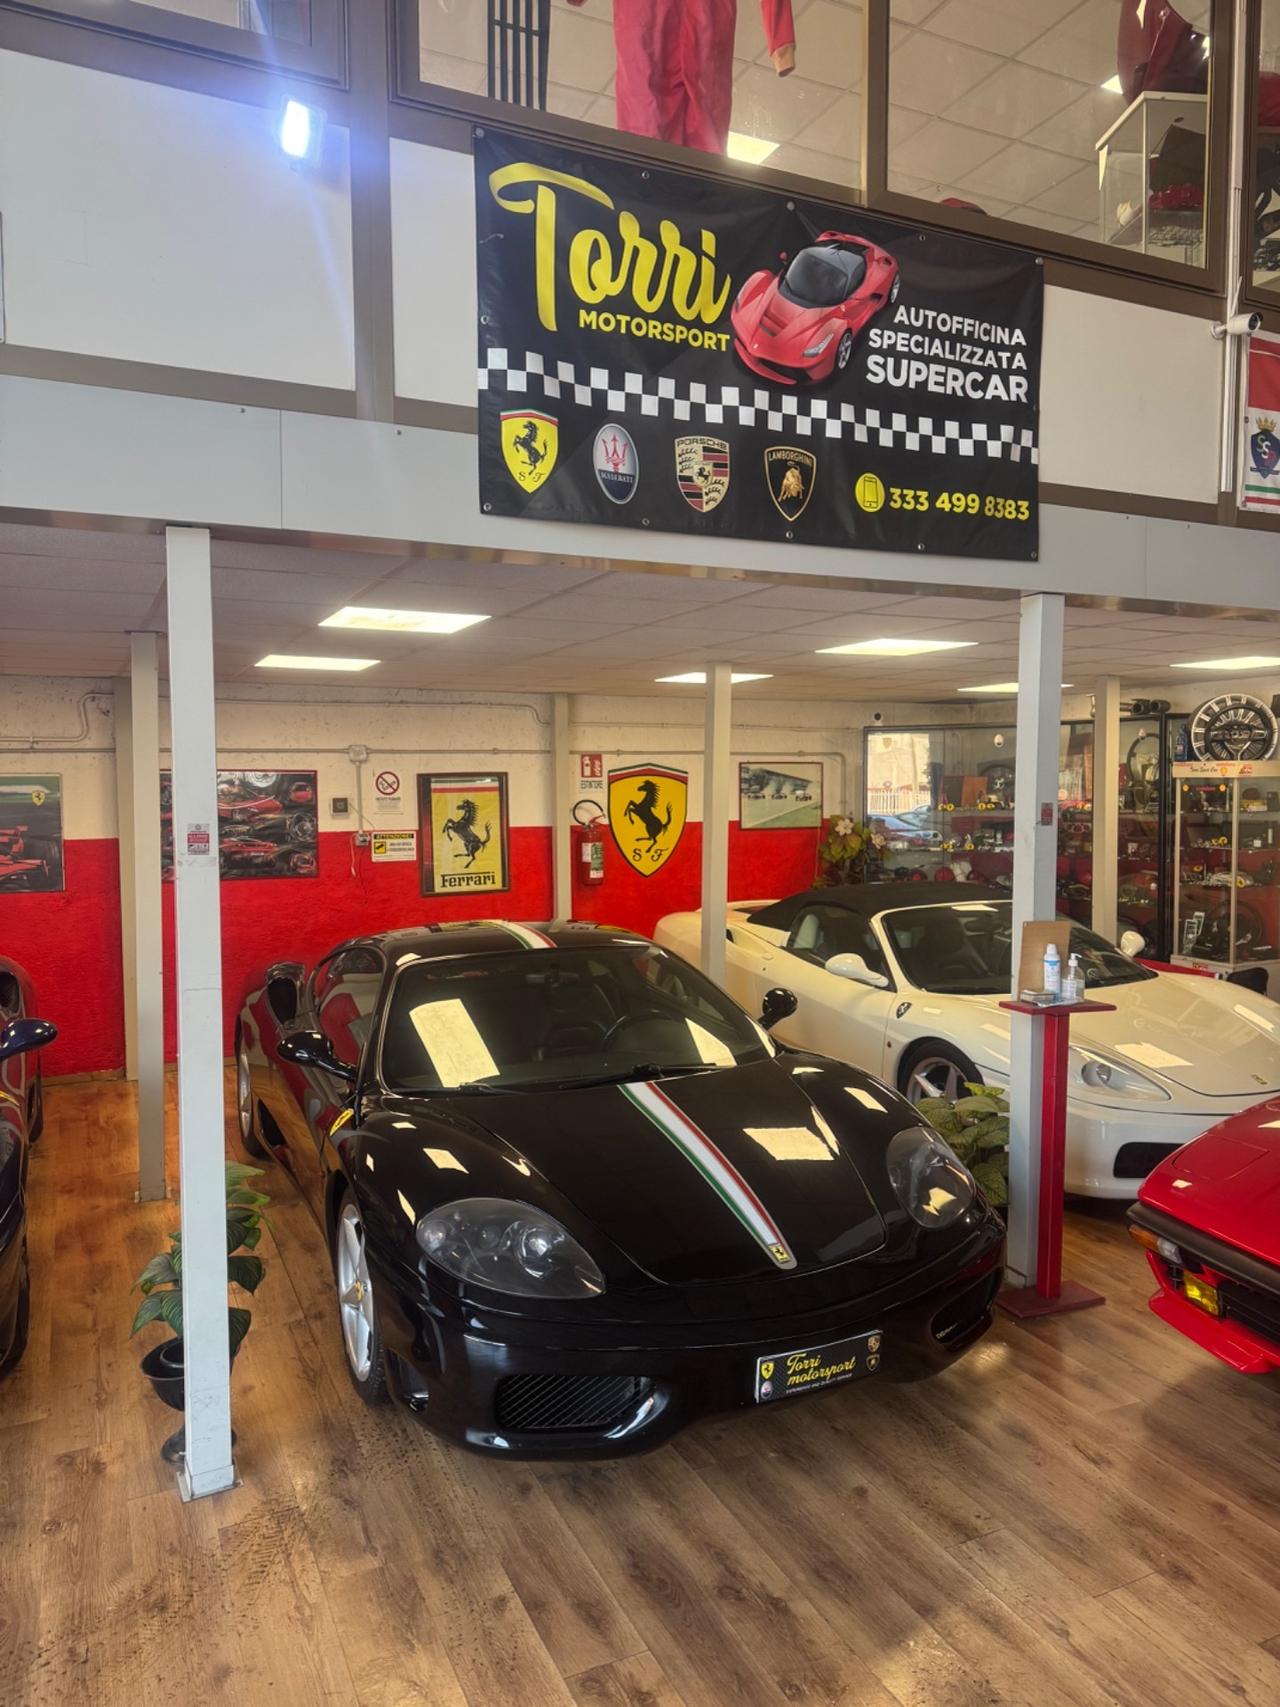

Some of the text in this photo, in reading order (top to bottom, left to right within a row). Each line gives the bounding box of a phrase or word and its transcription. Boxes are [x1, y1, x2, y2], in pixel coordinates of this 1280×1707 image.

[489, 162, 731, 331] Torri
[579, 309, 730, 351] MOTORSPORT
[894, 305, 1027, 346] AUTOFFICINA
[868, 328, 1027, 370] SPECIALIZZATA
[866, 354, 1029, 403] SUPERCAR
[677, 437, 727, 450] PORSCHE
[768, 450, 813, 465] LAMBORGHINI
[600, 471, 633, 483] MASERATI
[889, 487, 1030, 520] 333 499 8383
[632, 848, 642, 862] S
[440, 871, 496, 888] Ferrari
[787, 1352, 821, 1375] Torri
[787, 1356, 856, 1386] motorsport
